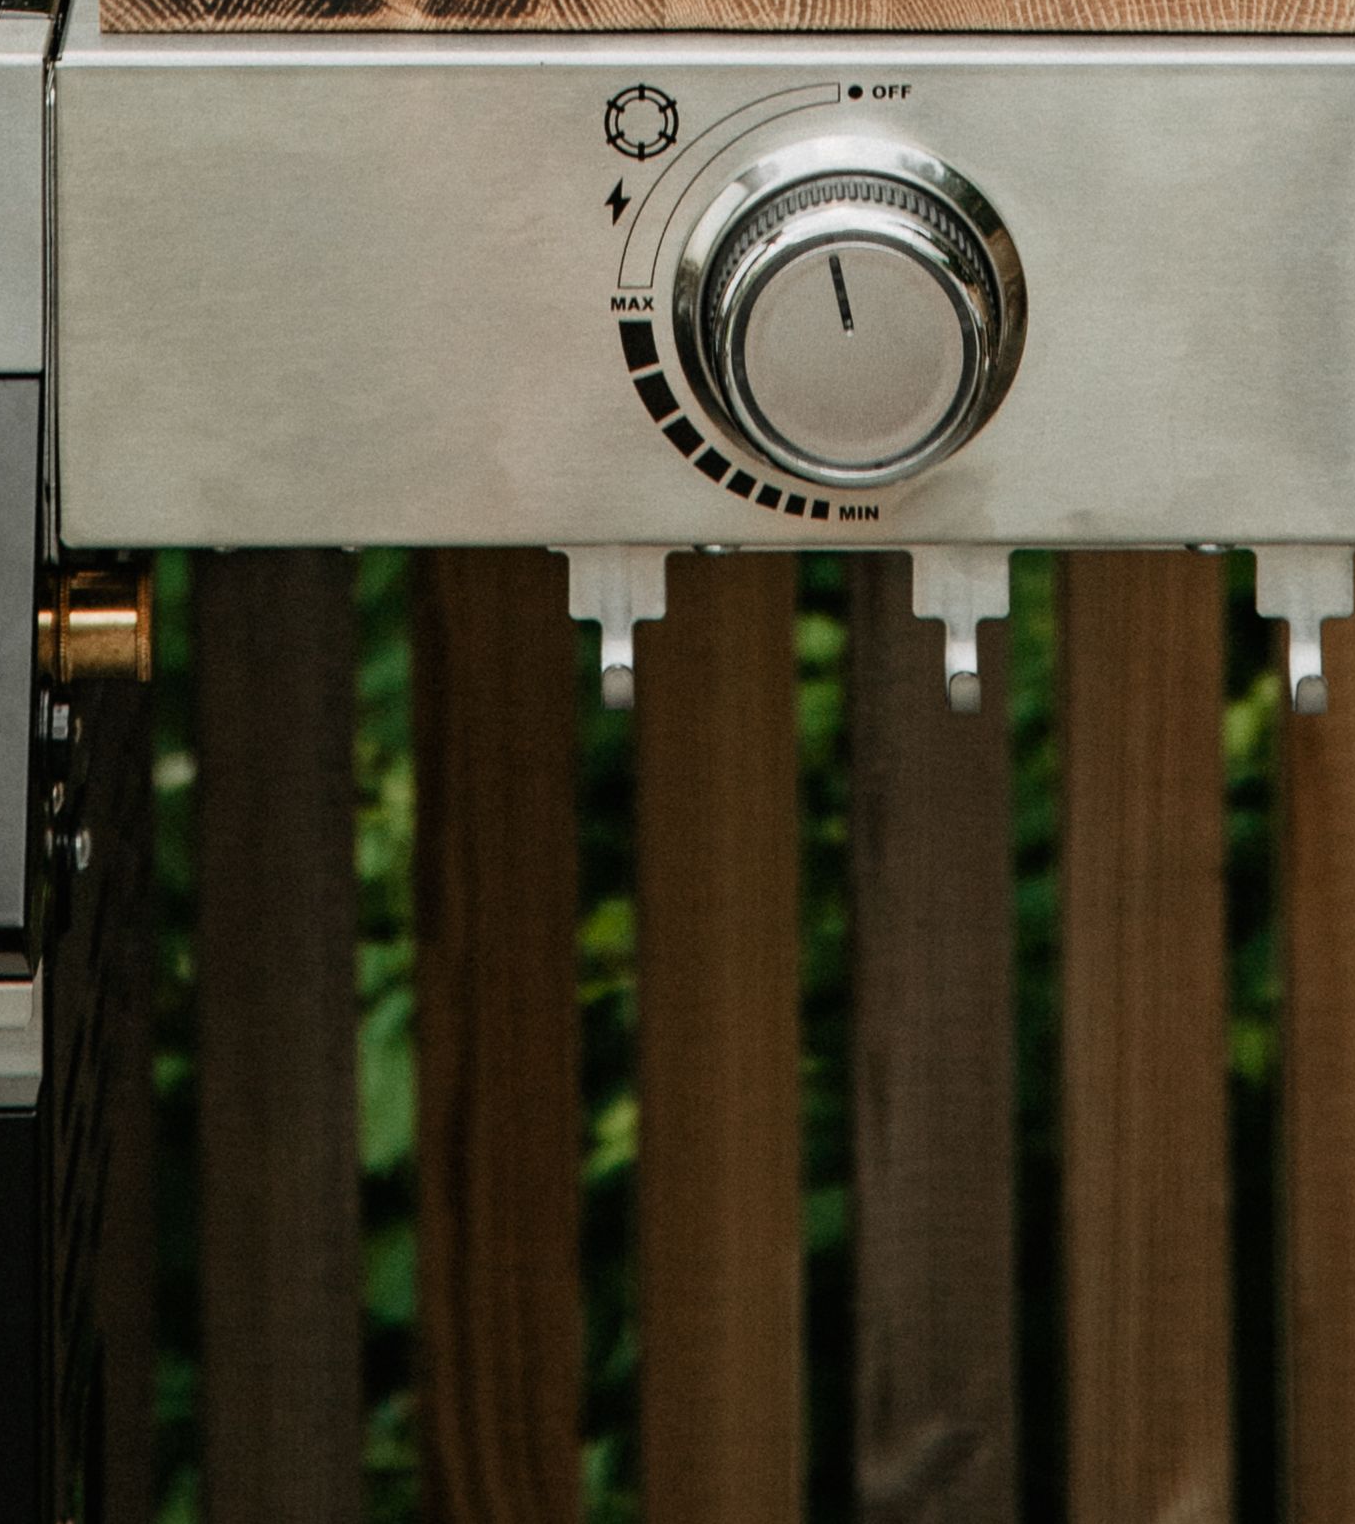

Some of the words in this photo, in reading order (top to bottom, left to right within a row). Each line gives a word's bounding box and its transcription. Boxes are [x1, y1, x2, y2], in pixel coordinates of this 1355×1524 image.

[872, 86, 912, 100] OFF
[610, 296, 655, 312] MAX
[839, 505, 879, 520] MIN
